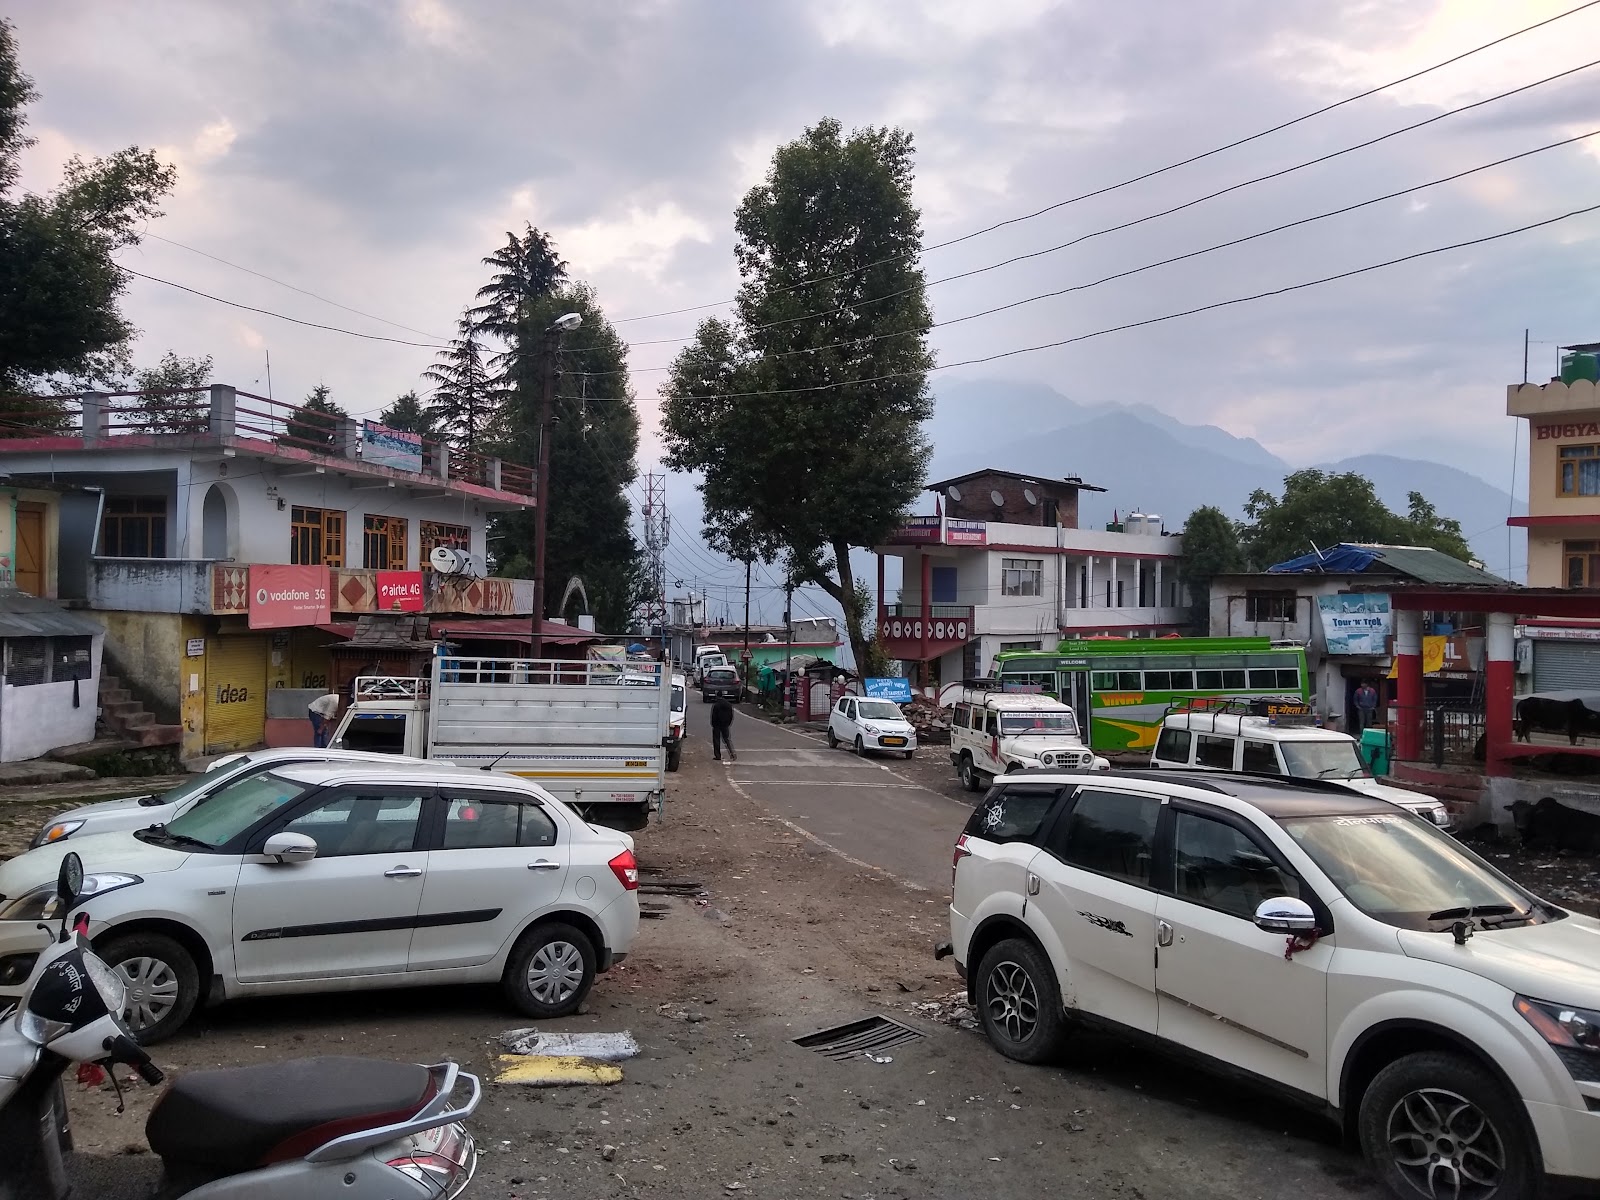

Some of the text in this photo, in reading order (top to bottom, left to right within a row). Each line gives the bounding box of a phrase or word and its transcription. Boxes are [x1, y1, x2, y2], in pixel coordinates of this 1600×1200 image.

[1536, 422, 1600, 440] BUGYA
[270, 589, 326, 601] vodafone 3G
[389, 583, 420, 596] airtel 4G
[1332, 618, 1352, 627] Tour
[1363, 617, 1382, 627] Trek
[216, 683, 248, 704] Idea
